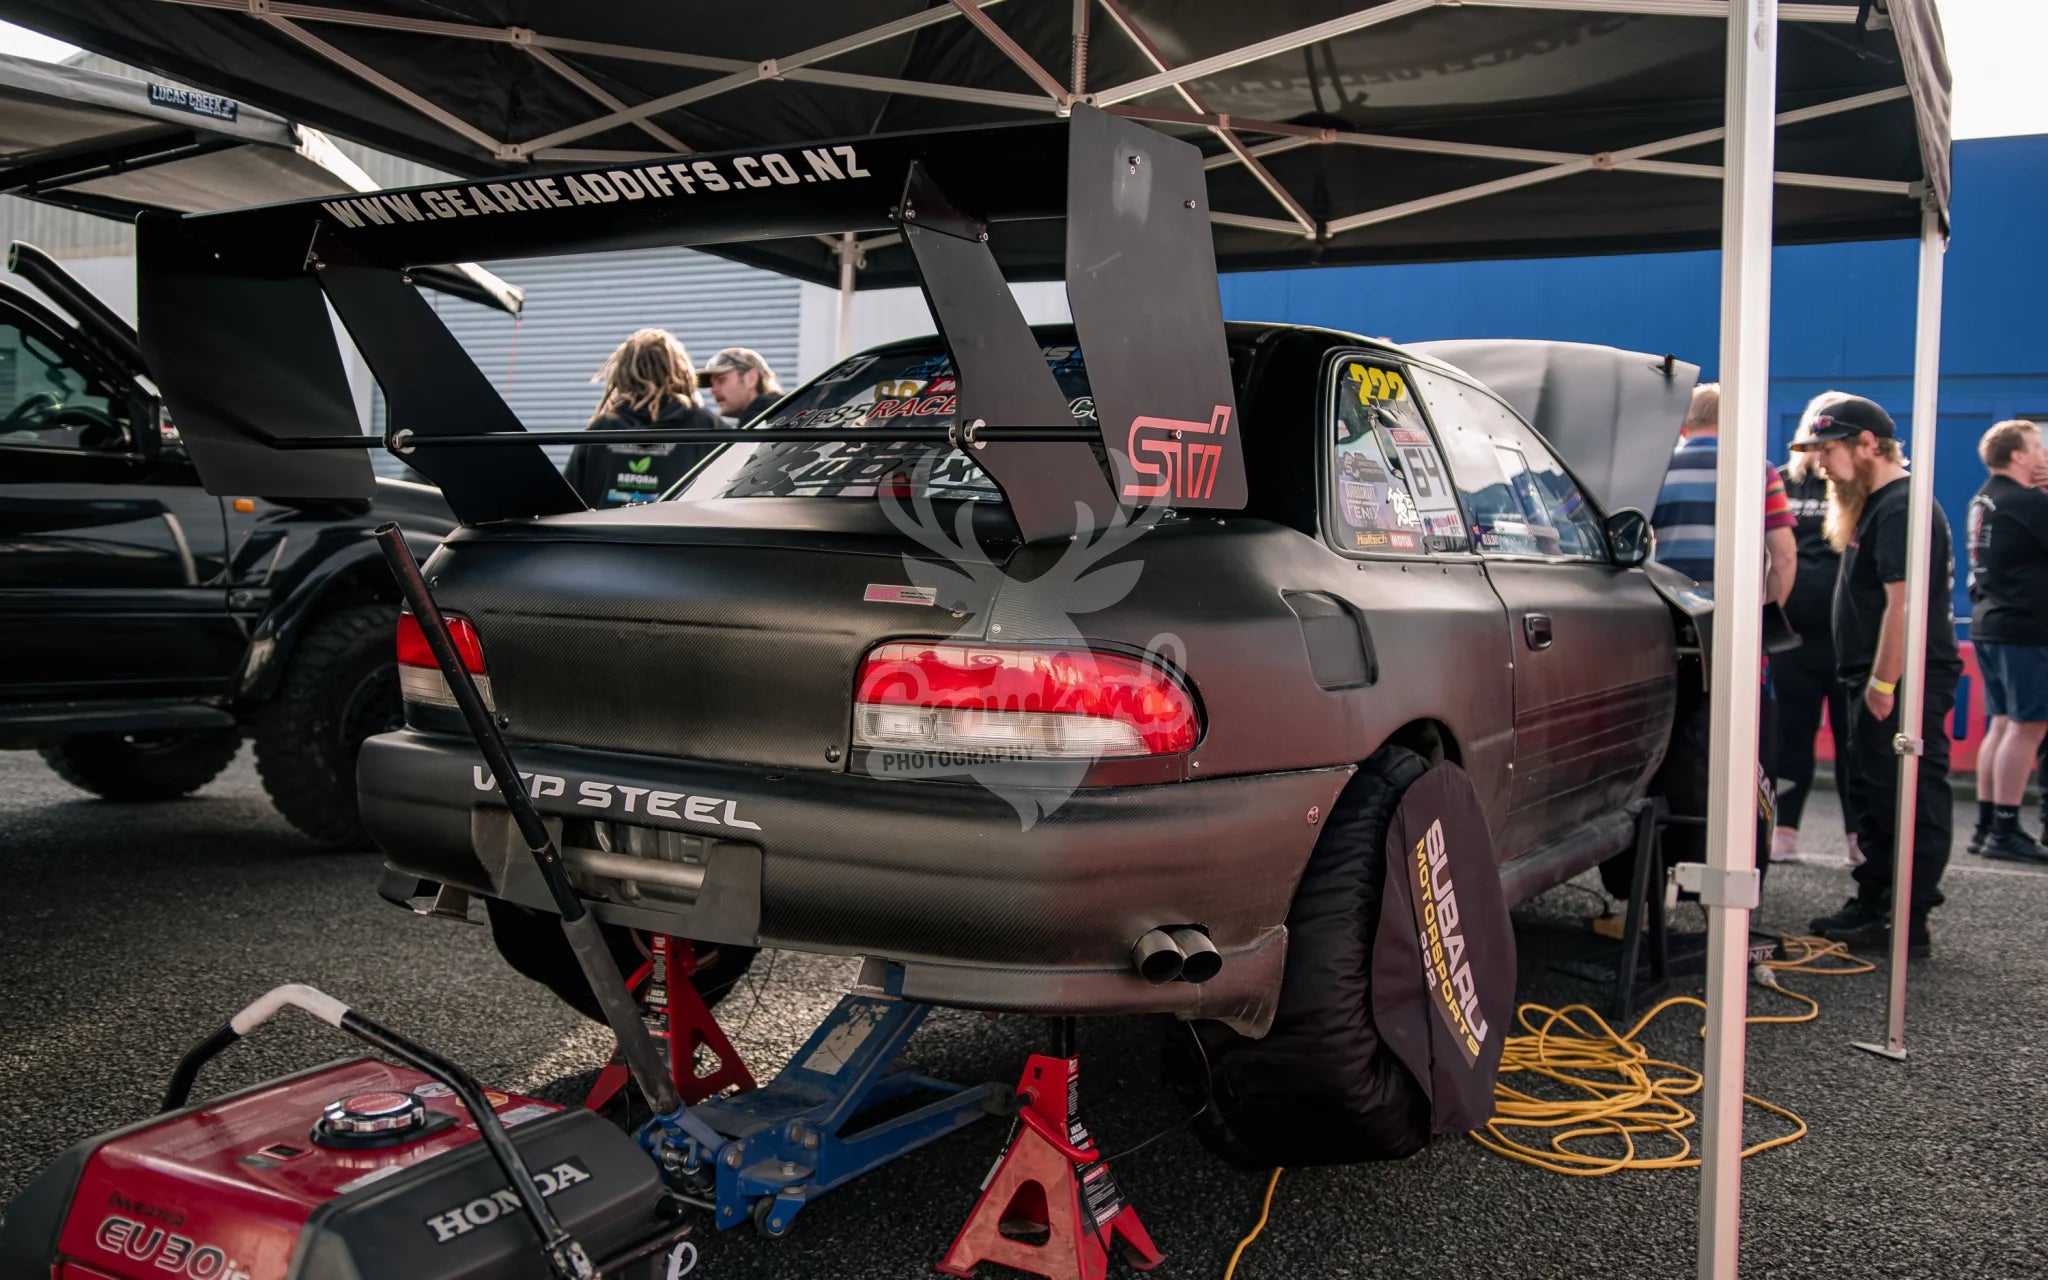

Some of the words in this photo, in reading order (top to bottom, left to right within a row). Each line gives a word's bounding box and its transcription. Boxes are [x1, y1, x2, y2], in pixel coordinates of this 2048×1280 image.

[152, 85, 187, 104] LUCAS
[189, 92, 222, 111] CREEK
[321, 146, 871, 228] WWW.GEARHEADDIFFS.CO.NZ
[1403, 447, 1447, 498] 64
[473, 765, 566, 799] VP
[577, 780, 762, 831] STEEL
[1415, 837, 1480, 1057] MOTORSPORTS
[1426, 818, 1489, 1042] SUBARU
